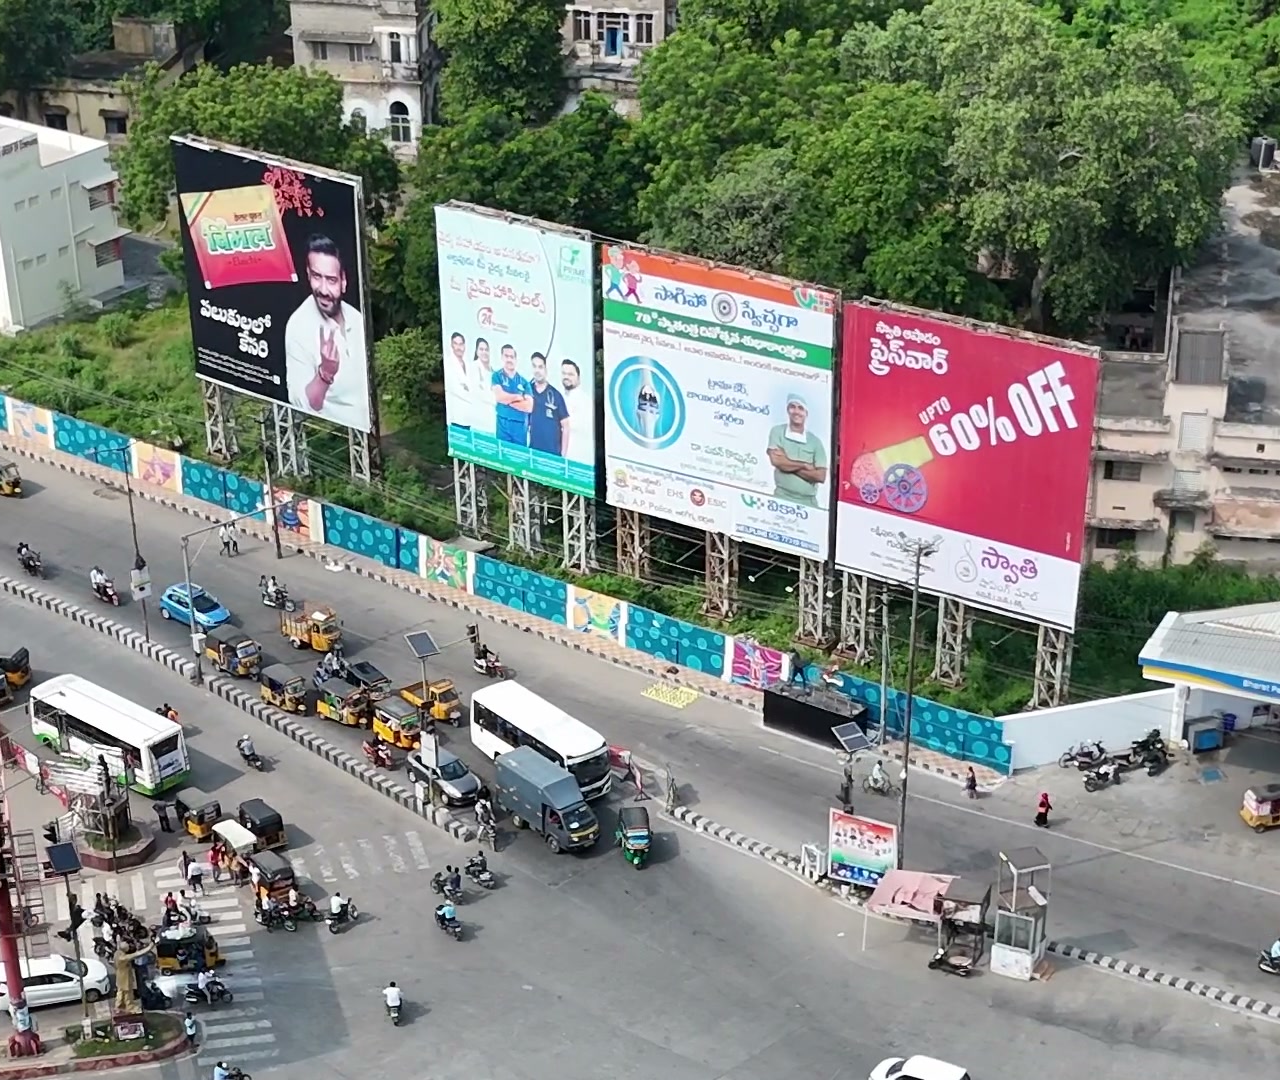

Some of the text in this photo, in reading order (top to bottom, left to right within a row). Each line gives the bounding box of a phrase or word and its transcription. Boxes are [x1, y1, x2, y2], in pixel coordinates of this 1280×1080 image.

[204, 223, 273, 252] विमल
[481, 313, 492, 326] 24
[238, 331, 268, 358] కేసరి
[918, 396, 951, 425] UPTO
[928, 360, 1078, 456] 60% OFF
[667, 488, 684, 499] EHS
[767, 500, 809, 520] వికాస్
[981, 546, 1038, 584] స్వాతి
[1243, 680, 1270, 692] Bharat
